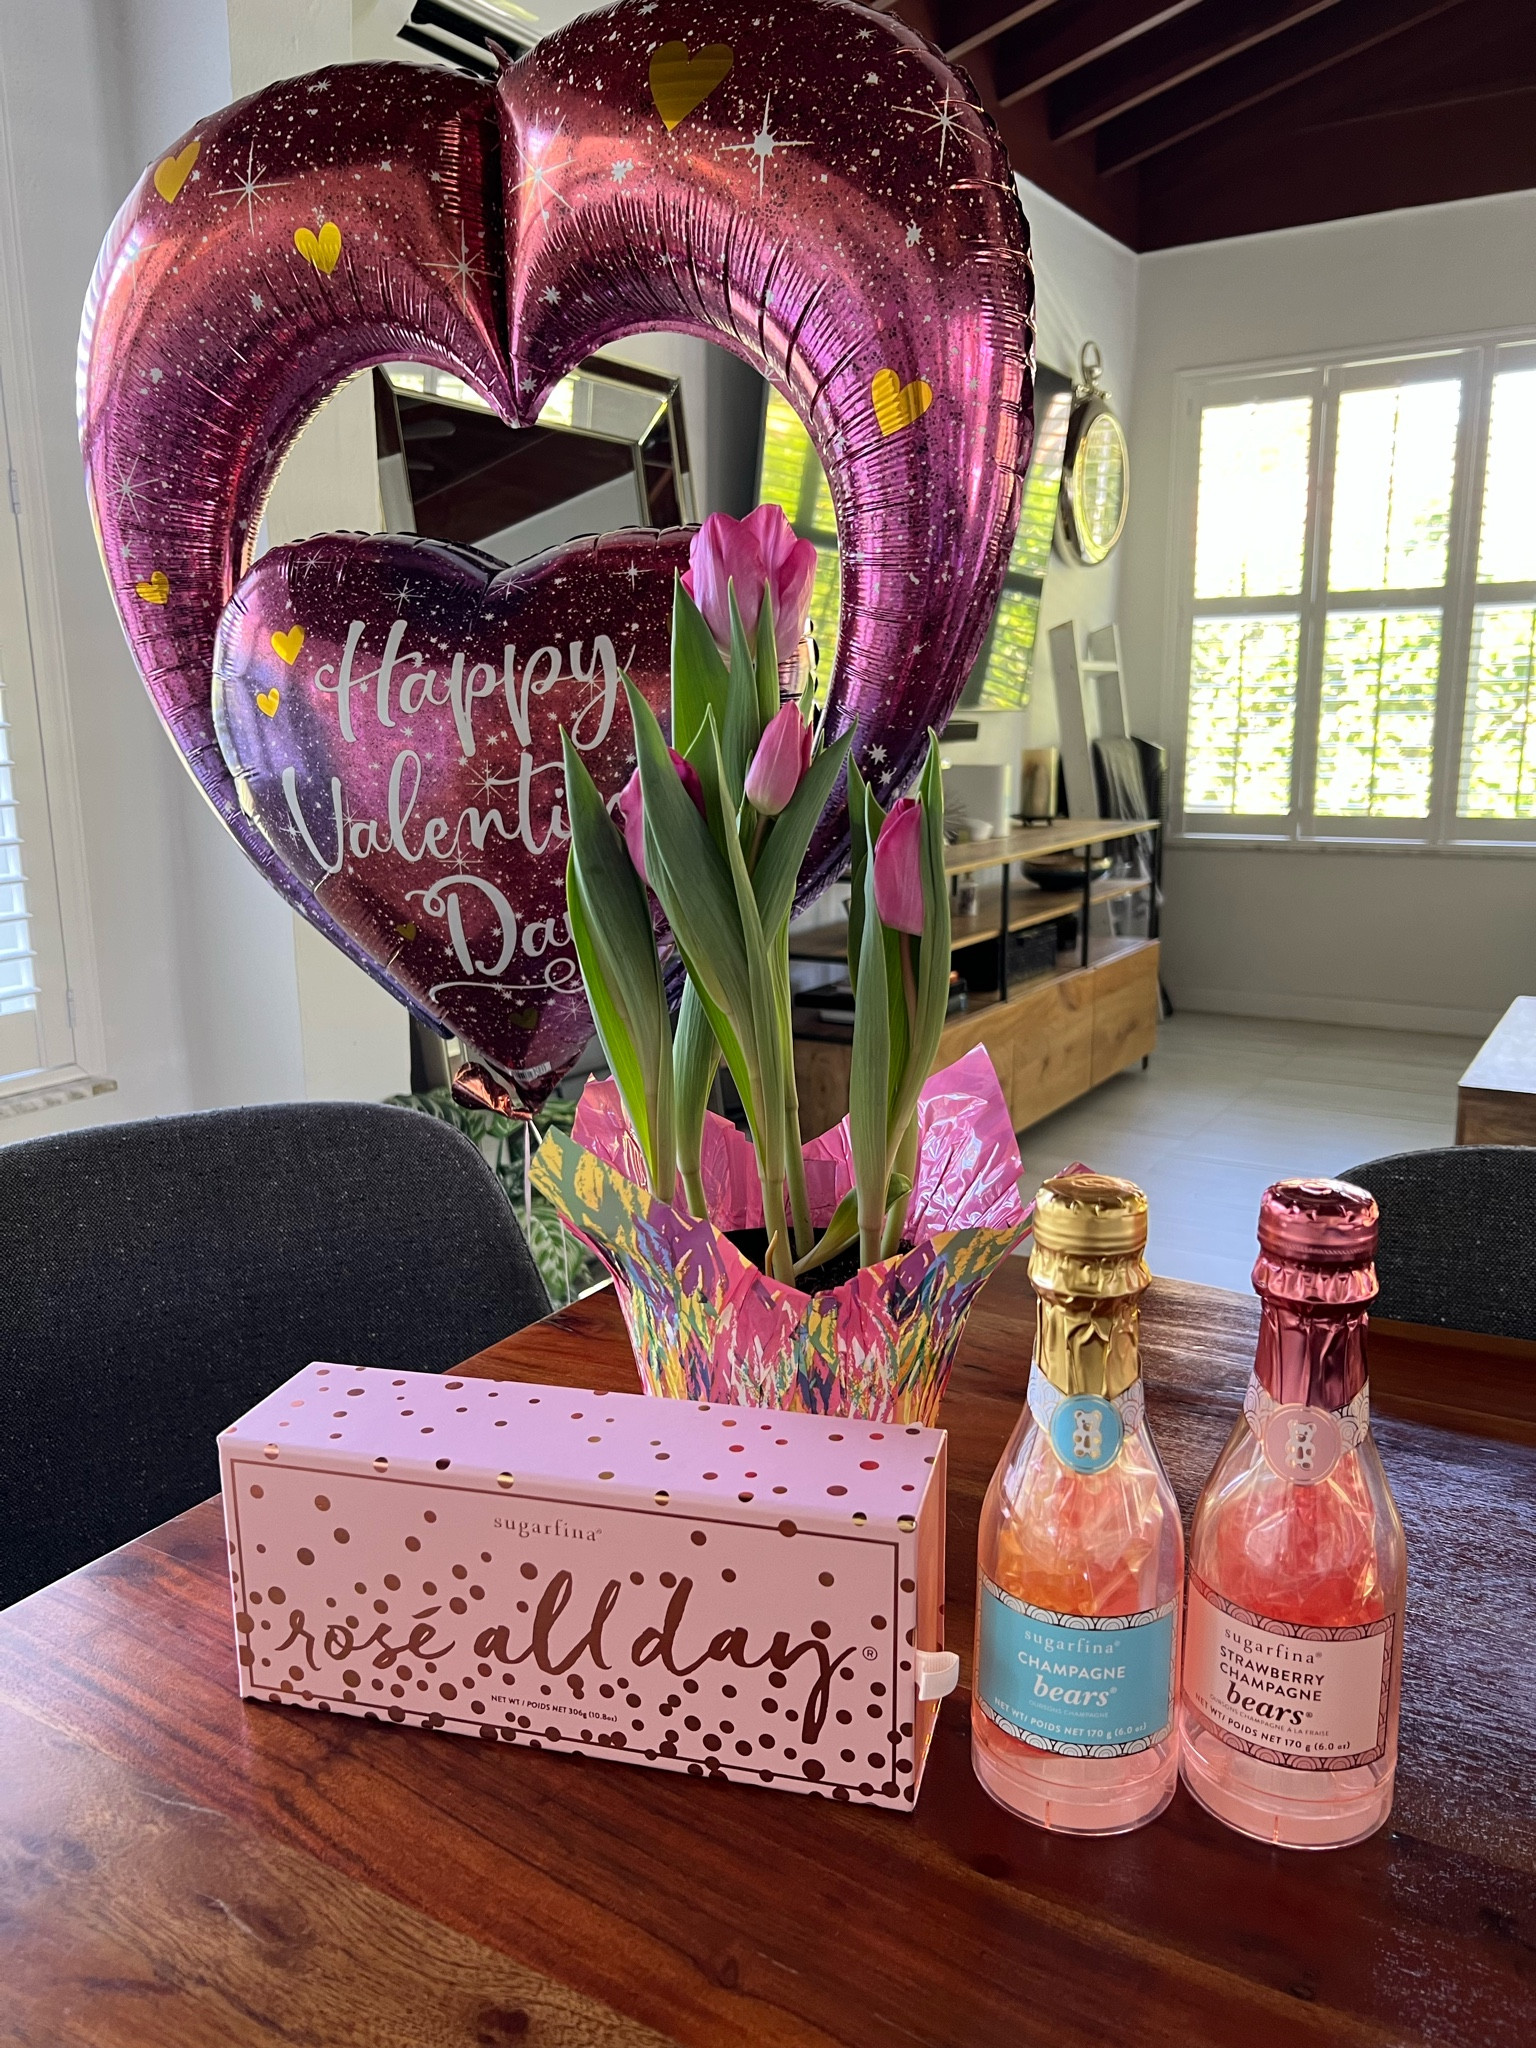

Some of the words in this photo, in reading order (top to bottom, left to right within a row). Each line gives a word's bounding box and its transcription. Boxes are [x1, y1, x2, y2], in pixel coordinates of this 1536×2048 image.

[314, 619, 636, 757] Happy
[282, 749, 620, 874] Valenti
[405, 874, 578, 980] Da
[275, 1606, 455, 1671] rosé
[474, 1570, 620, 1675] all
[1018, 1650, 1126, 1680] CHAMPAGNE
[1219, 1662, 1322, 1702] CHAMPAGNE
[1220, 1645, 1325, 1686] STRAWBERRY
[491, 1694, 507, 1703] NET
[508, 1698, 521, 1706] WT
[527, 1700, 551, 1711] POIDS
[552, 1705, 567, 1714] NET
[995, 1697, 1010, 1712] NET
[1031, 1717, 1061, 1733] POIDS
[1064, 1726, 1085, 1737] NET
[1087, 1729, 1104, 1738] 170
[1196, 1693, 1208, 1709] NET
[1228, 1717, 1258, 1737] POIDS
[1261, 1732, 1282, 1744] NET
[1285, 1738, 1302, 1748] 170
